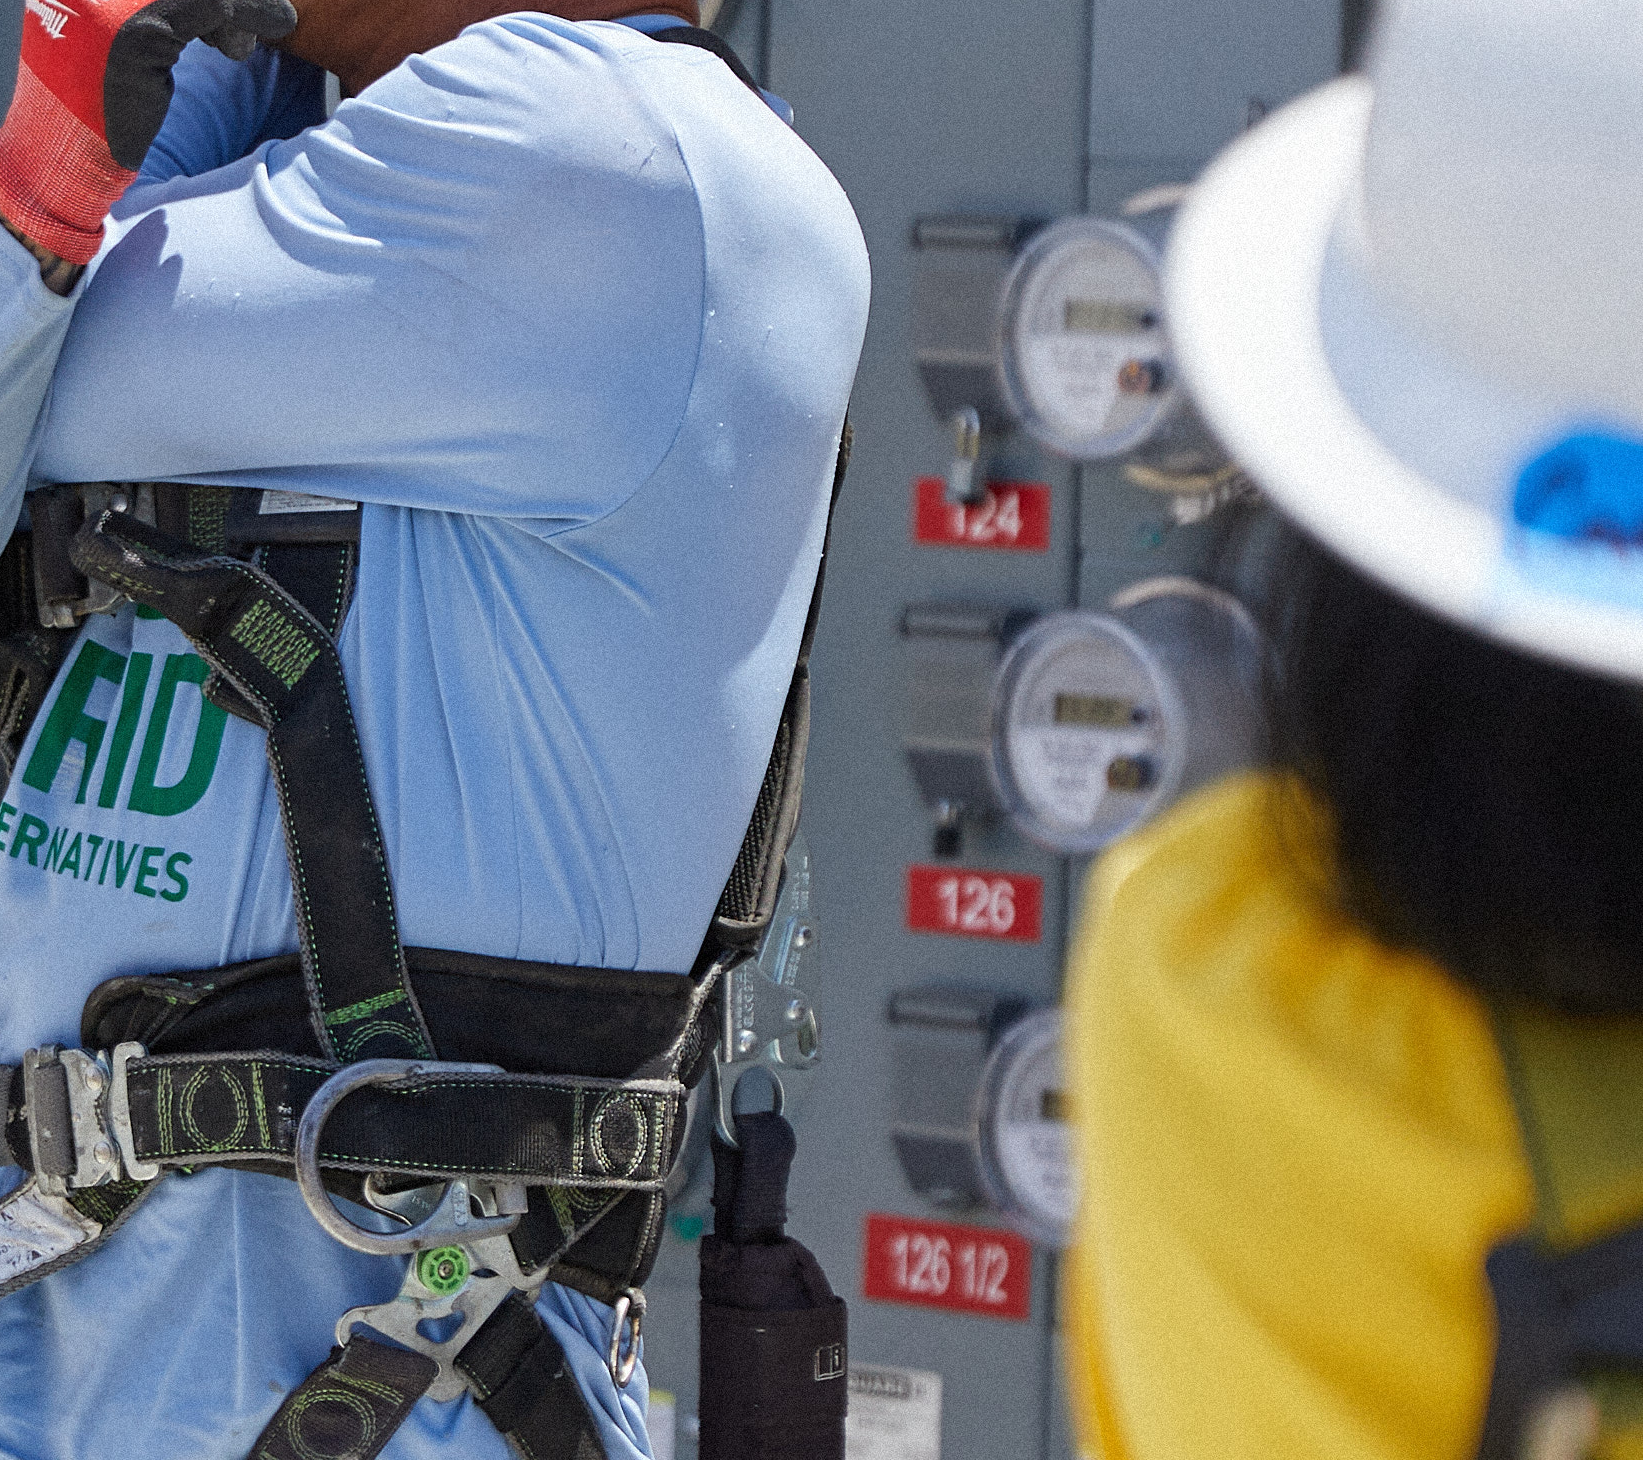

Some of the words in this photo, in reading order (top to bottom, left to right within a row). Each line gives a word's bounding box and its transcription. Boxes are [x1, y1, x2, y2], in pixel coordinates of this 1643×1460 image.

[949, 490, 1024, 542] 124
[936, 875, 1016, 935] 126
[889, 1232, 953, 1297] 126
[957, 1242, 1010, 1305] 1/2
